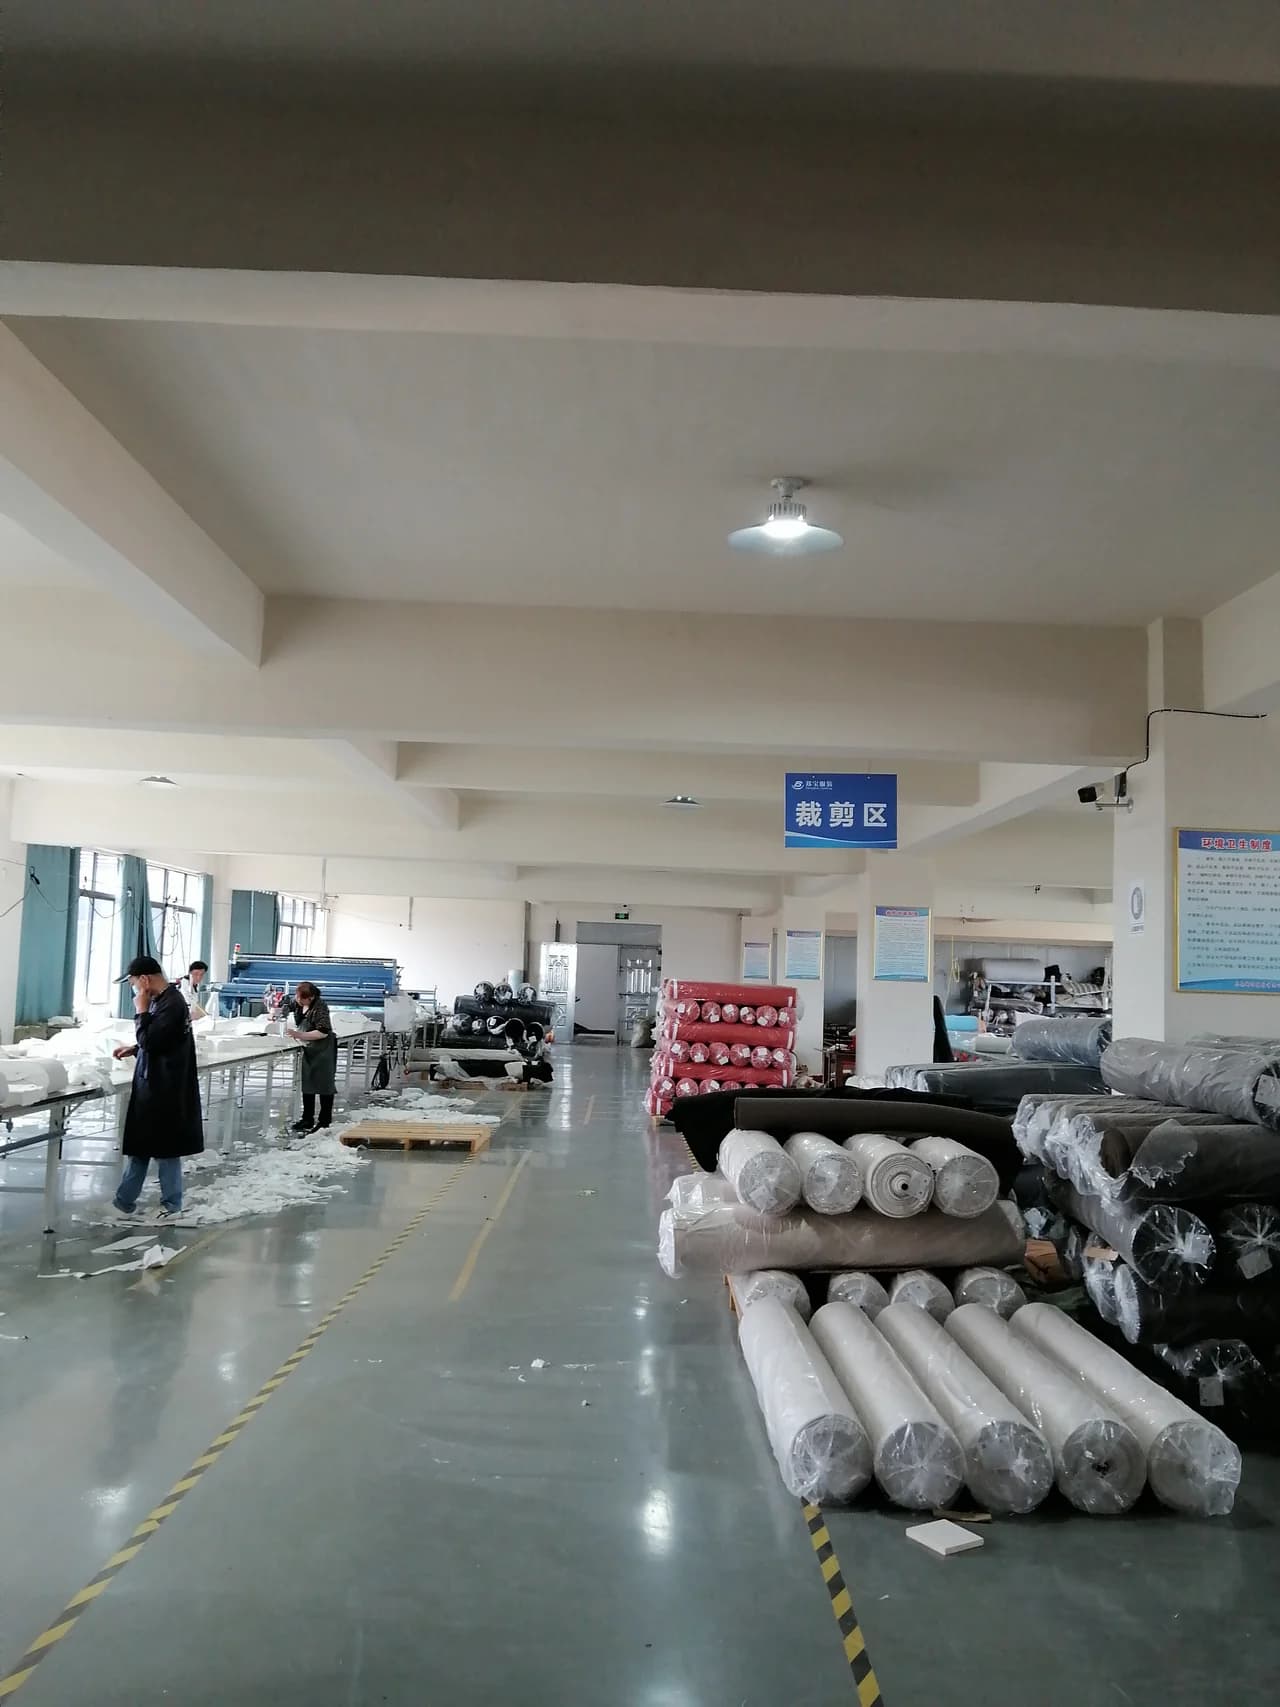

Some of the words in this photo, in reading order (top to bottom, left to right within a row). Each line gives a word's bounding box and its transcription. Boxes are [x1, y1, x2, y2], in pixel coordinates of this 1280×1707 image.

[796, 801, 887, 827] 裁剪区
[1201, 838, 1272, 851] 环境卫生制度
